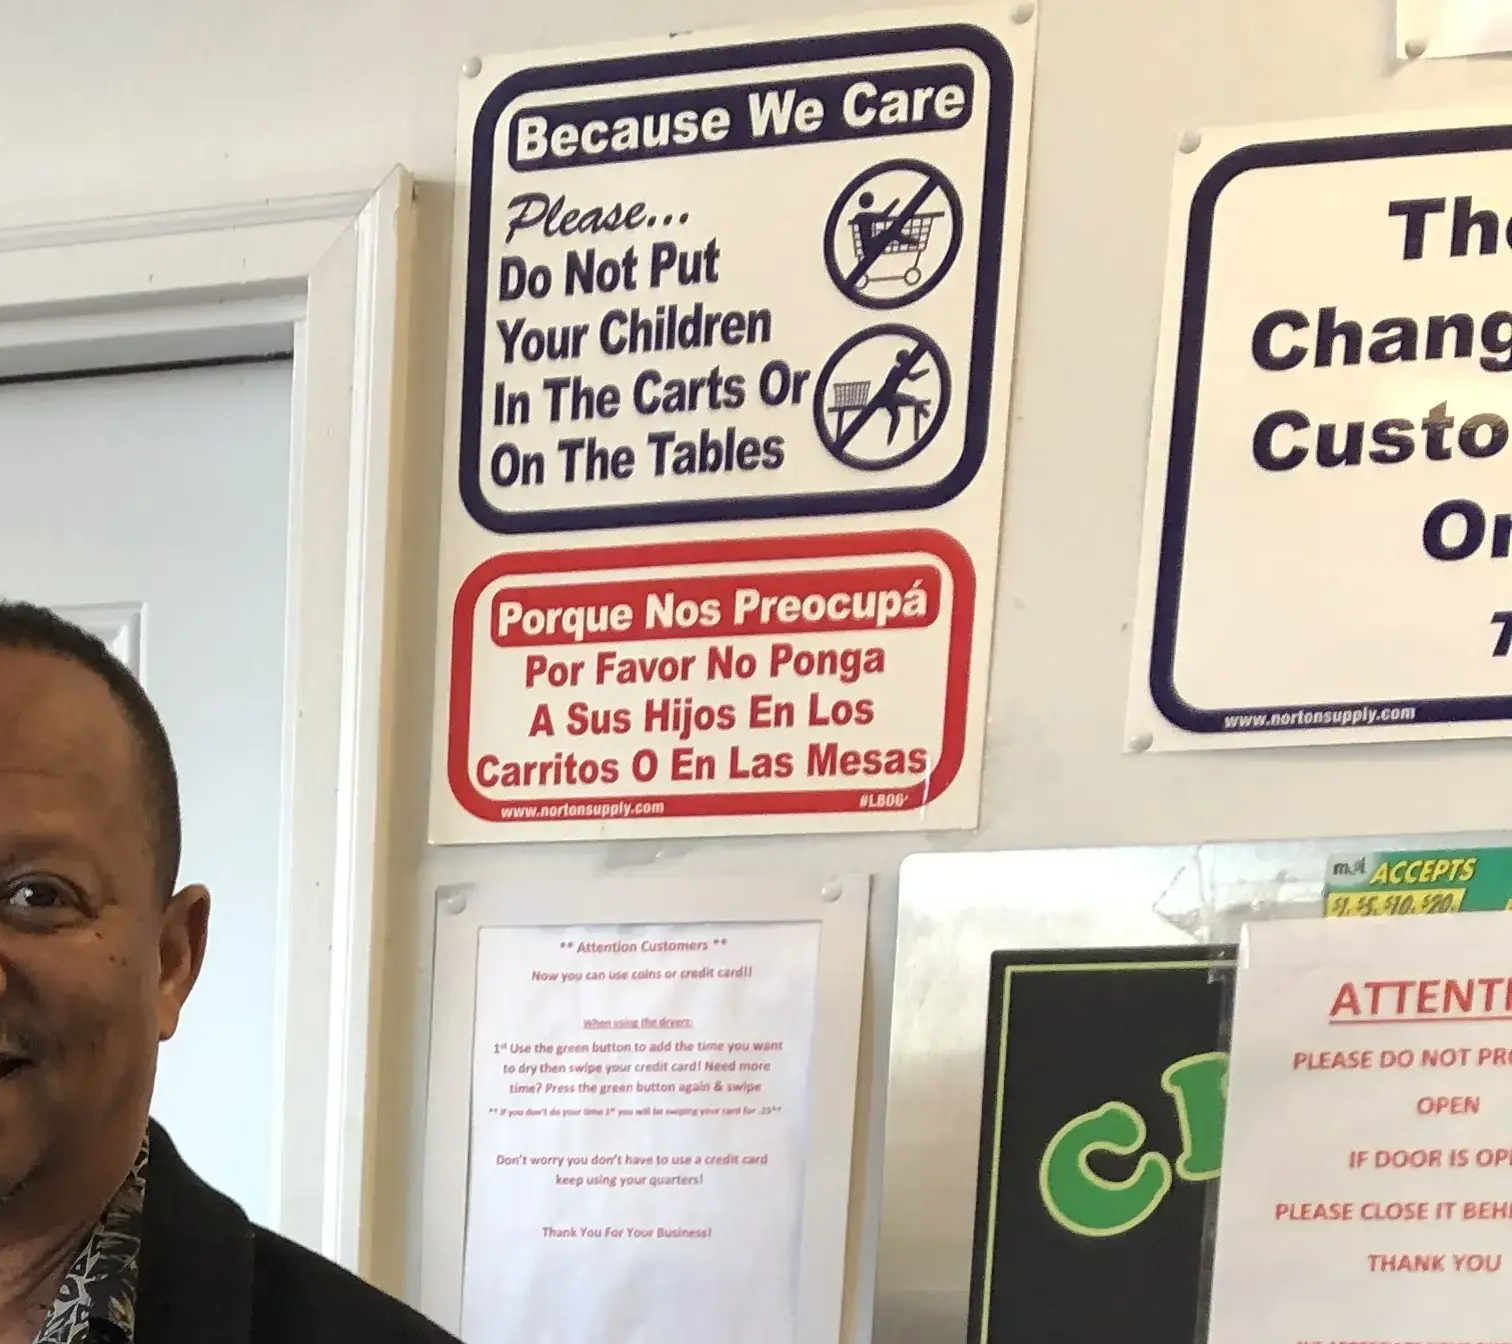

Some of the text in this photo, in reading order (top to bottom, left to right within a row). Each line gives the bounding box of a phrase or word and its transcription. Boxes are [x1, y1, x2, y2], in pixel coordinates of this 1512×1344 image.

[516, 81, 966, 162] Because We Care
[505, 191, 690, 244] Please...
[1389, 195, 1512, 260] Th
[498, 238, 721, 301] Do Not Put
[495, 306, 773, 364] Your Children
[494, 359, 812, 426] In The Carts Or
[490, 425, 786, 488] On The Tables
[498, 580, 928, 641] Porque Nos Preocupá
[525, 643, 885, 688] Por Favor No Ponga
[528, 692, 874, 740] A Sus Hijos En Los
[1224, 707, 1416, 729] www.nortonsupply.com
[475, 743, 928, 787] Carritos O En Las Mesas
[501, 799, 665, 819] www.nortonsupply.com
[1369, 858, 1477, 885] ACCEPTS
[577, 939, 708, 953] Attention Customers
[531, 966, 752, 983] Now you can use coins or credit card!!
[510, 1043, 532, 1054] Use
[534, 1042, 554, 1053] the
[555, 1044, 589, 1055] green
[592, 1041, 631, 1053] button
[634, 1042, 646, 1052] to
[649, 1041, 671, 1052] add
[674, 1040, 693, 1052] the
[697, 1040, 724, 1051] time
[728, 1042, 749, 1053] you
[753, 1041, 784, 1051] want
[503, 1060, 771, 1075] to dry then swipe your credit card! Need more
[1292, 1050, 1374, 1071] PLEASE
[1380, 1049, 1414, 1068] DO
[1421, 1048, 1471, 1067] NOT
[509, 1081, 762, 1095] time? Press the green button again & swipe
[1417, 1096, 1480, 1115] OPEN
[496, 1154, 768, 1167] Don't worry you don't have to use a credit card
[1349, 1149, 1512, 1169] IF DOOR IS OP
[555, 1174, 704, 1187] keep using your quarters!
[1275, 1202, 1354, 1221] PLEASE
[1361, 1202, 1429, 1220] CLOSE
[1435, 1202, 1457, 1220] IT
[541, 1227, 712, 1238] Thank You For Your Business!
[1367, 1253, 1502, 1273] THANK YOU
